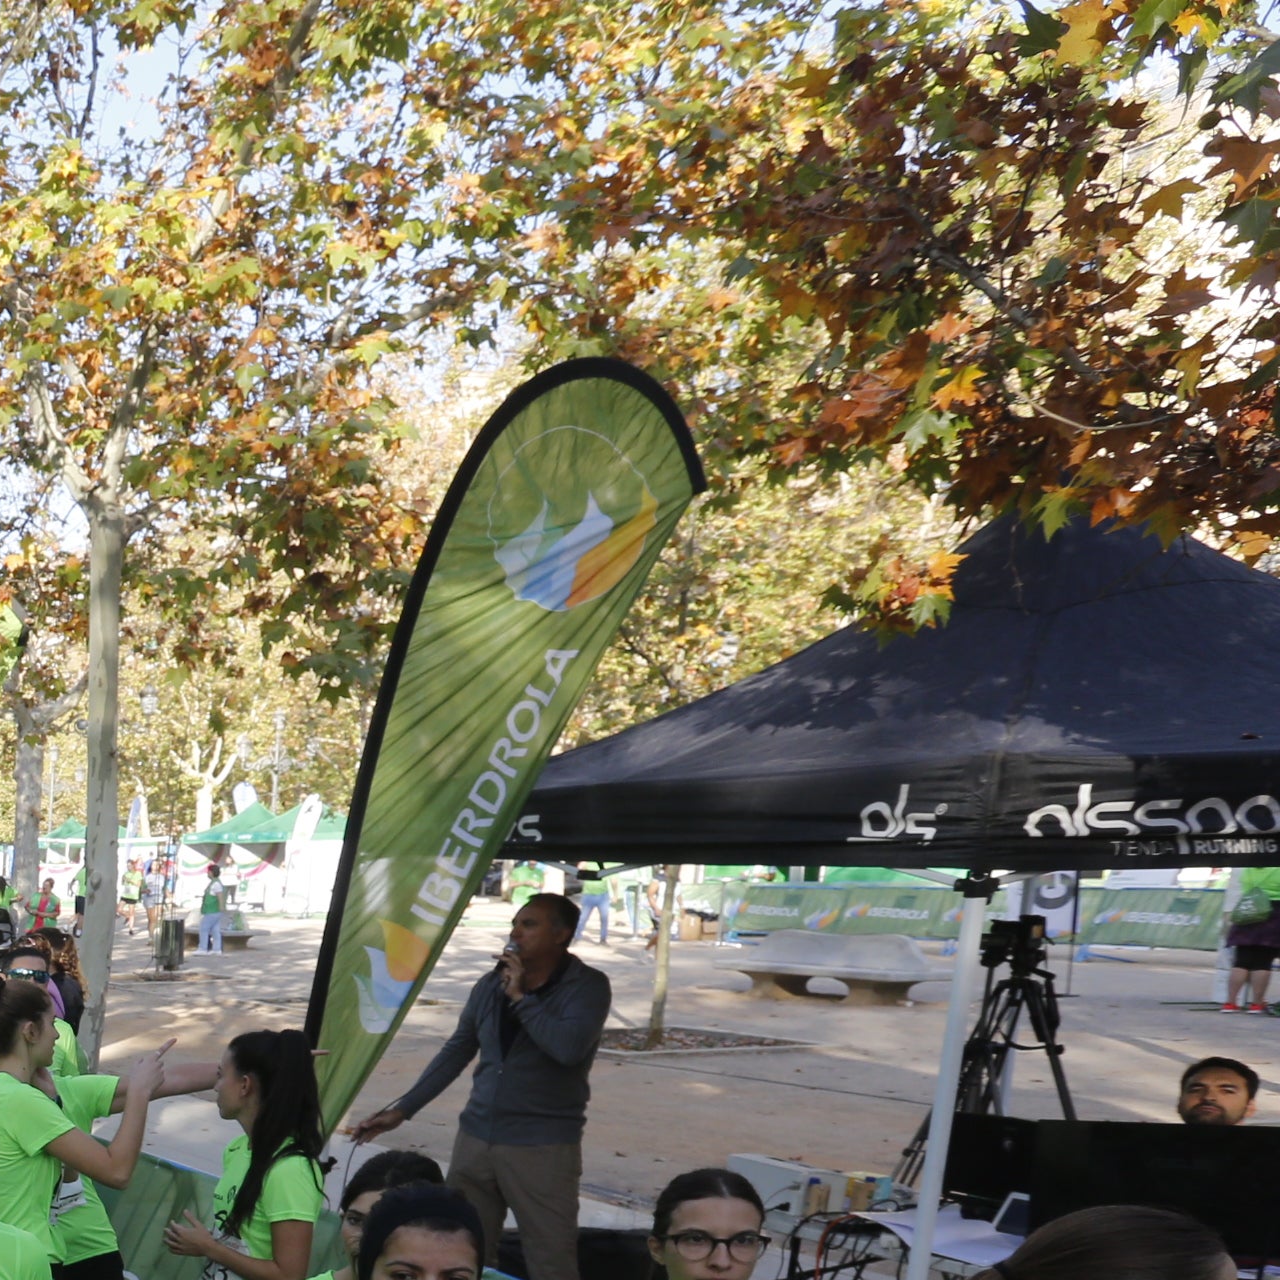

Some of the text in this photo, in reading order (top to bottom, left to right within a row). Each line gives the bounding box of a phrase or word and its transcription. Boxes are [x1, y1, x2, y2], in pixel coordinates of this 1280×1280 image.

[410, 648, 579, 926] IBERDROLA
[1194, 838, 1278, 854] RUNNING
[867, 907, 929, 920] IBERDROLA
[1126, 911, 1201, 926] IBERDROLA
